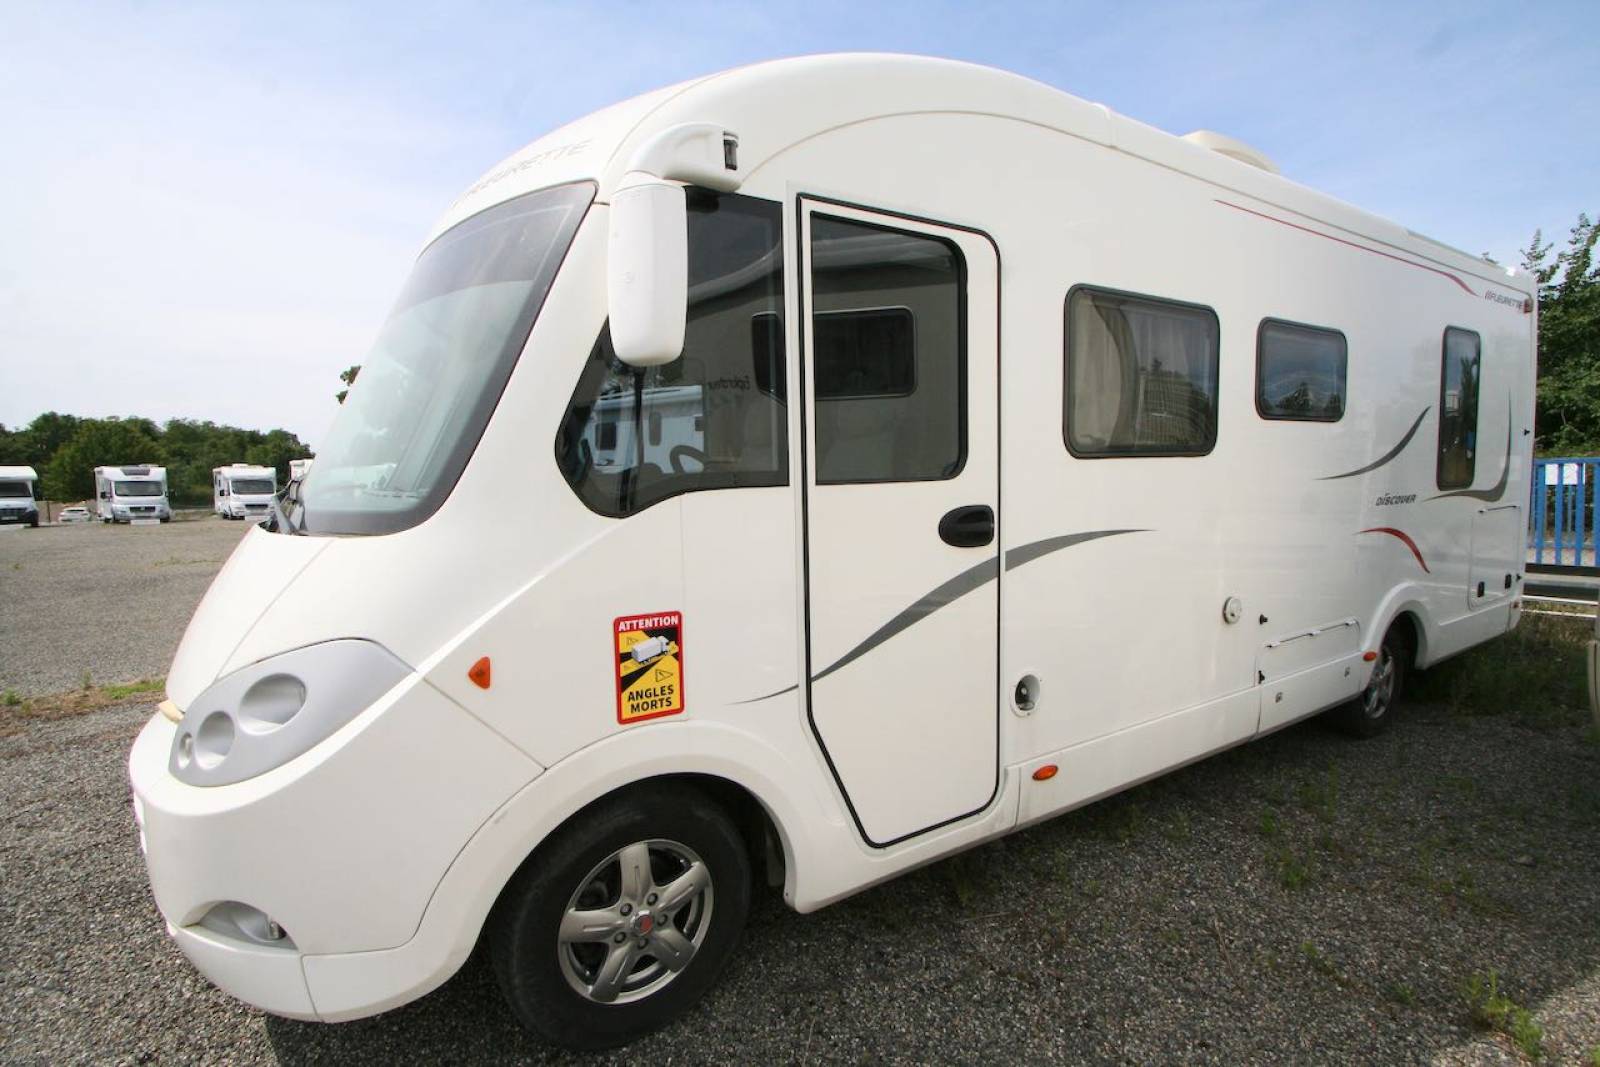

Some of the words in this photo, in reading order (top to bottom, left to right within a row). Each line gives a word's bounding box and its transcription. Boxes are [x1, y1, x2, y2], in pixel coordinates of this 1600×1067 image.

[1375, 493, 1417, 506] DISCOVER
[618, 615, 679, 632] ATTENTION
[627, 684, 674, 702] ANGLES
[630, 696, 673, 714] MORTS
